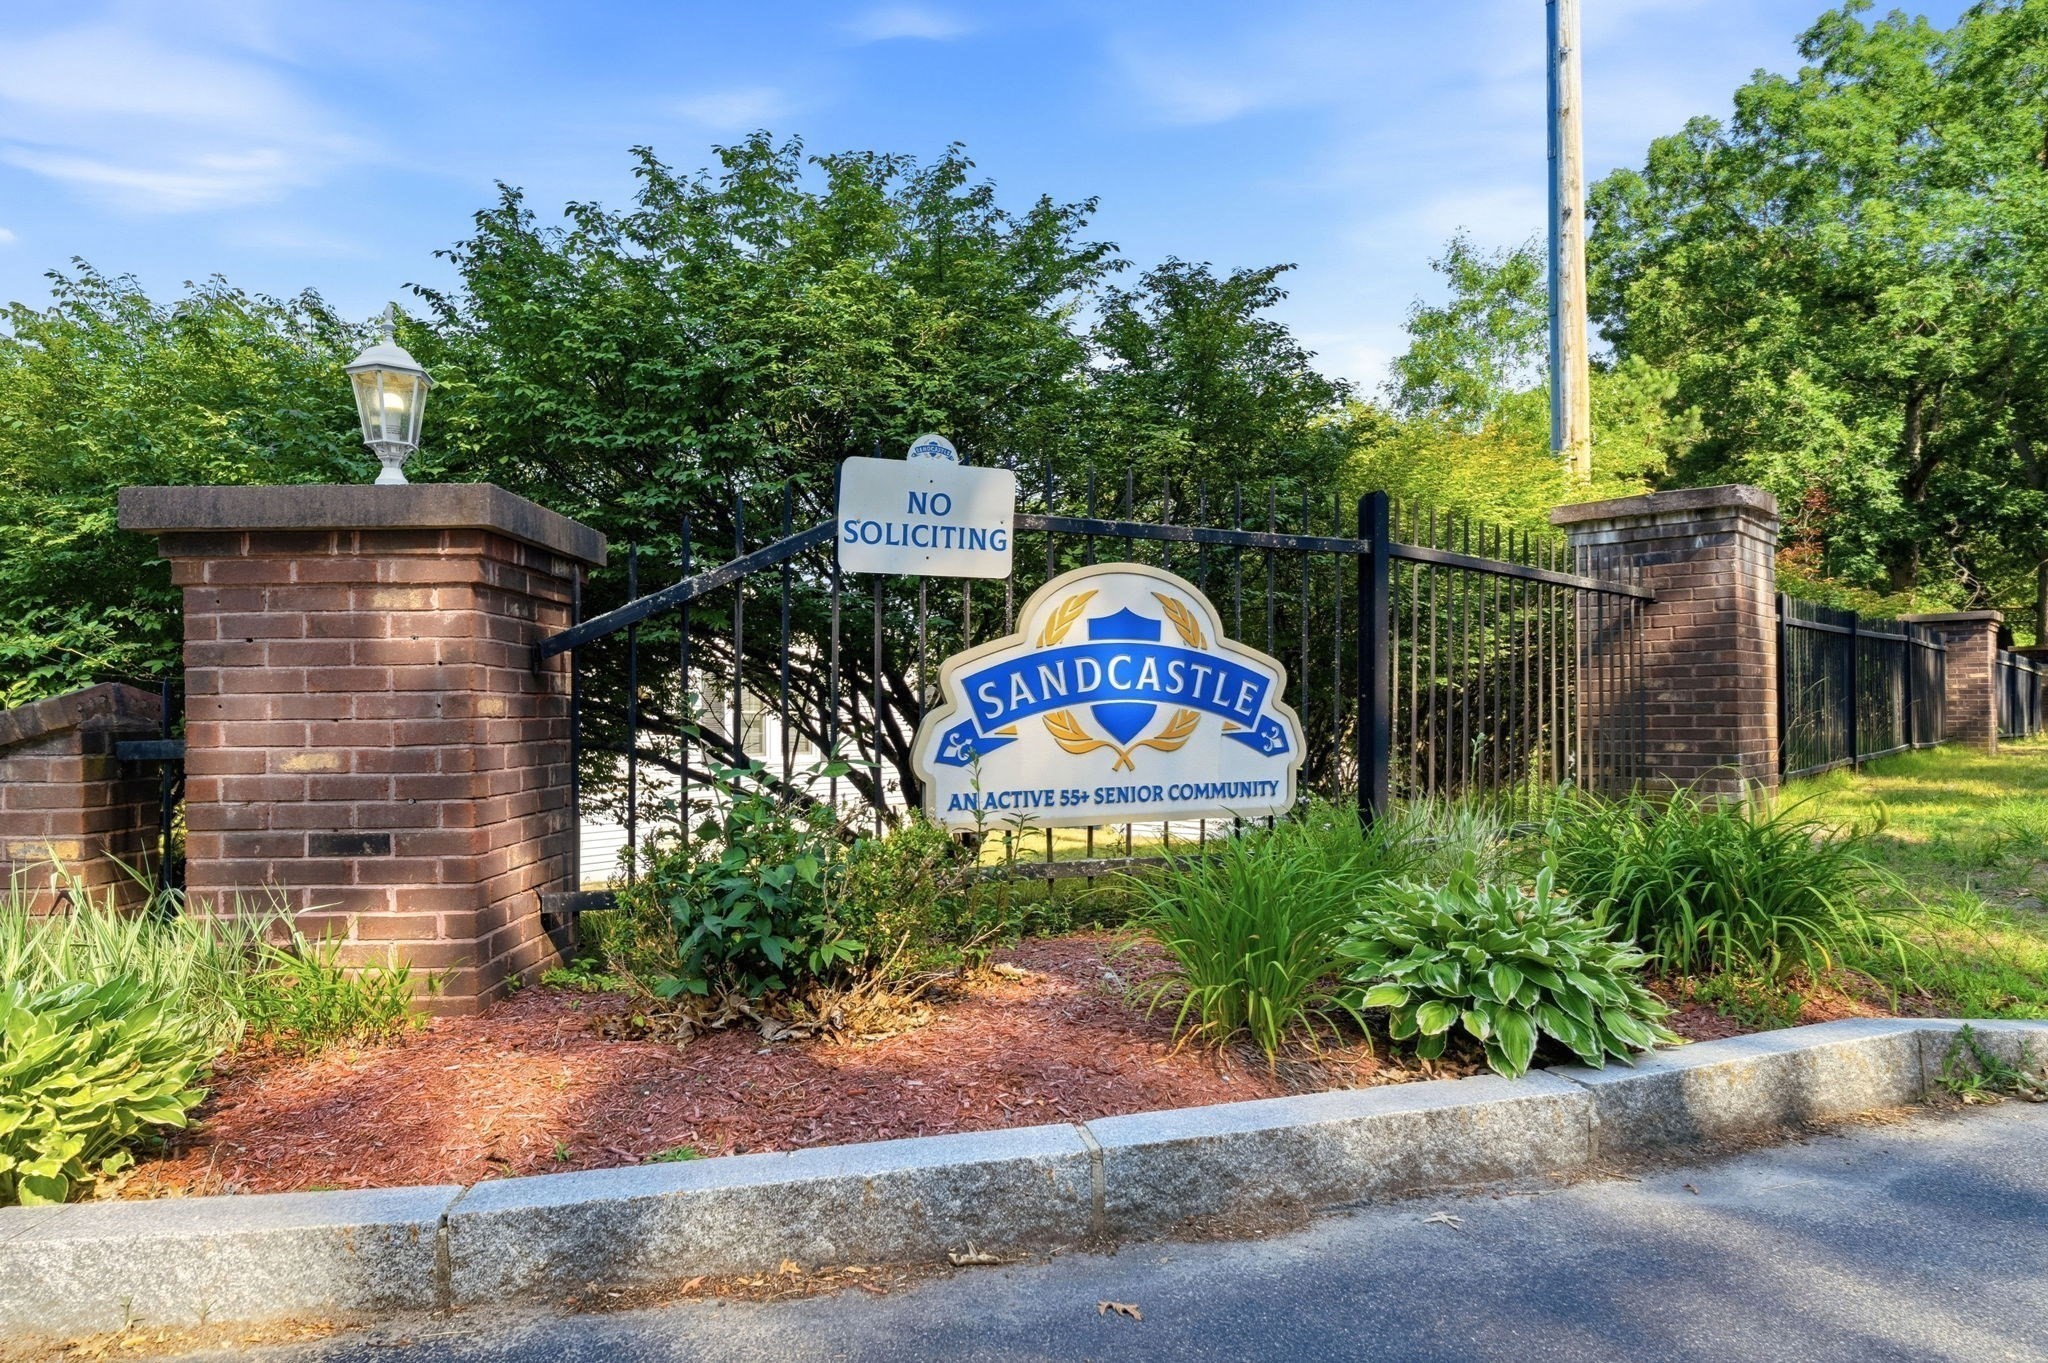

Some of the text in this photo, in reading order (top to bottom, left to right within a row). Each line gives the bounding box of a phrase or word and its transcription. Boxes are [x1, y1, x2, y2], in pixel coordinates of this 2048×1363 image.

[907, 491, 952, 517] NO
[843, 519, 1008, 552] SOLICITING
[977, 654, 1264, 720] SANDCASTLE
[947, 780, 1280, 812] AN ACTIVE 55+ SENIOR COMMUNITY
